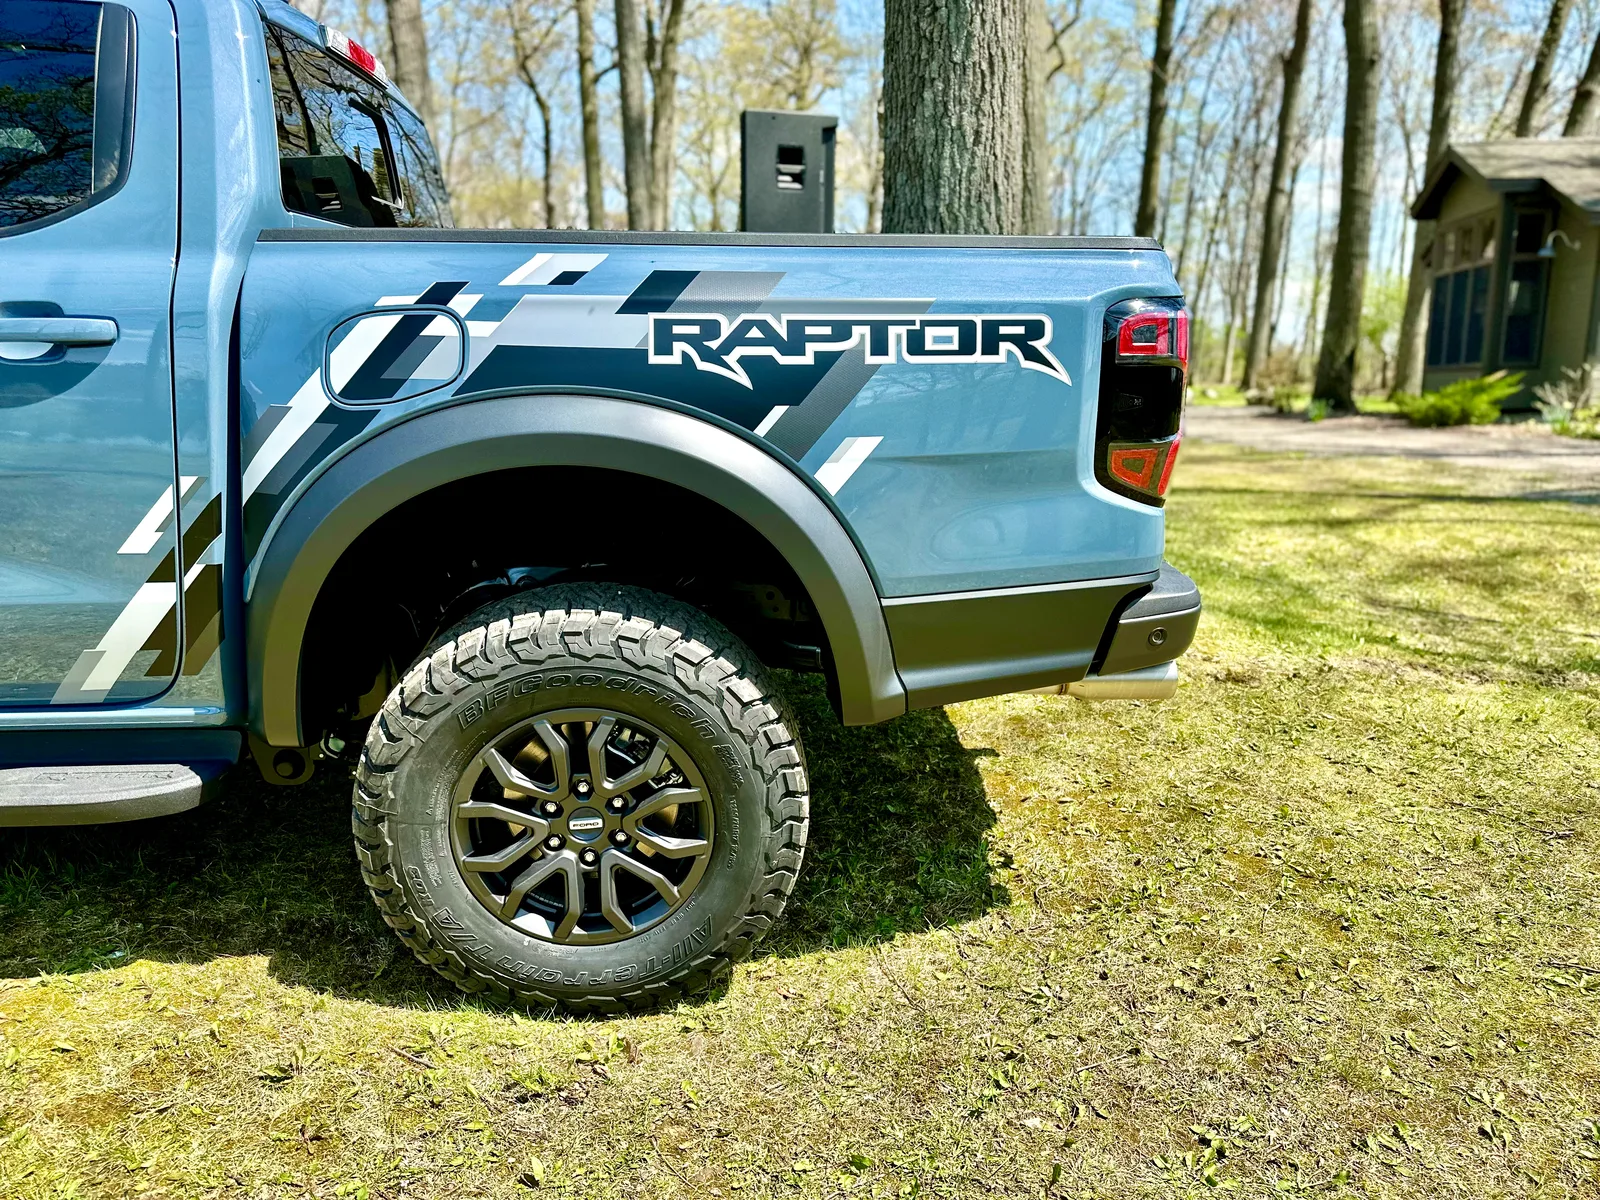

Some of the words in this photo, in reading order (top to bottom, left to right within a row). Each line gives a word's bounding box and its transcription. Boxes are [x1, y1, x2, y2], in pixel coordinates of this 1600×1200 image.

[648, 313, 1072, 390] RAPTOR
[457, 673, 718, 739] BFGoodrich
[433, 907, 493, 960] T/A
[496, 914, 713, 986] All-Terrain
